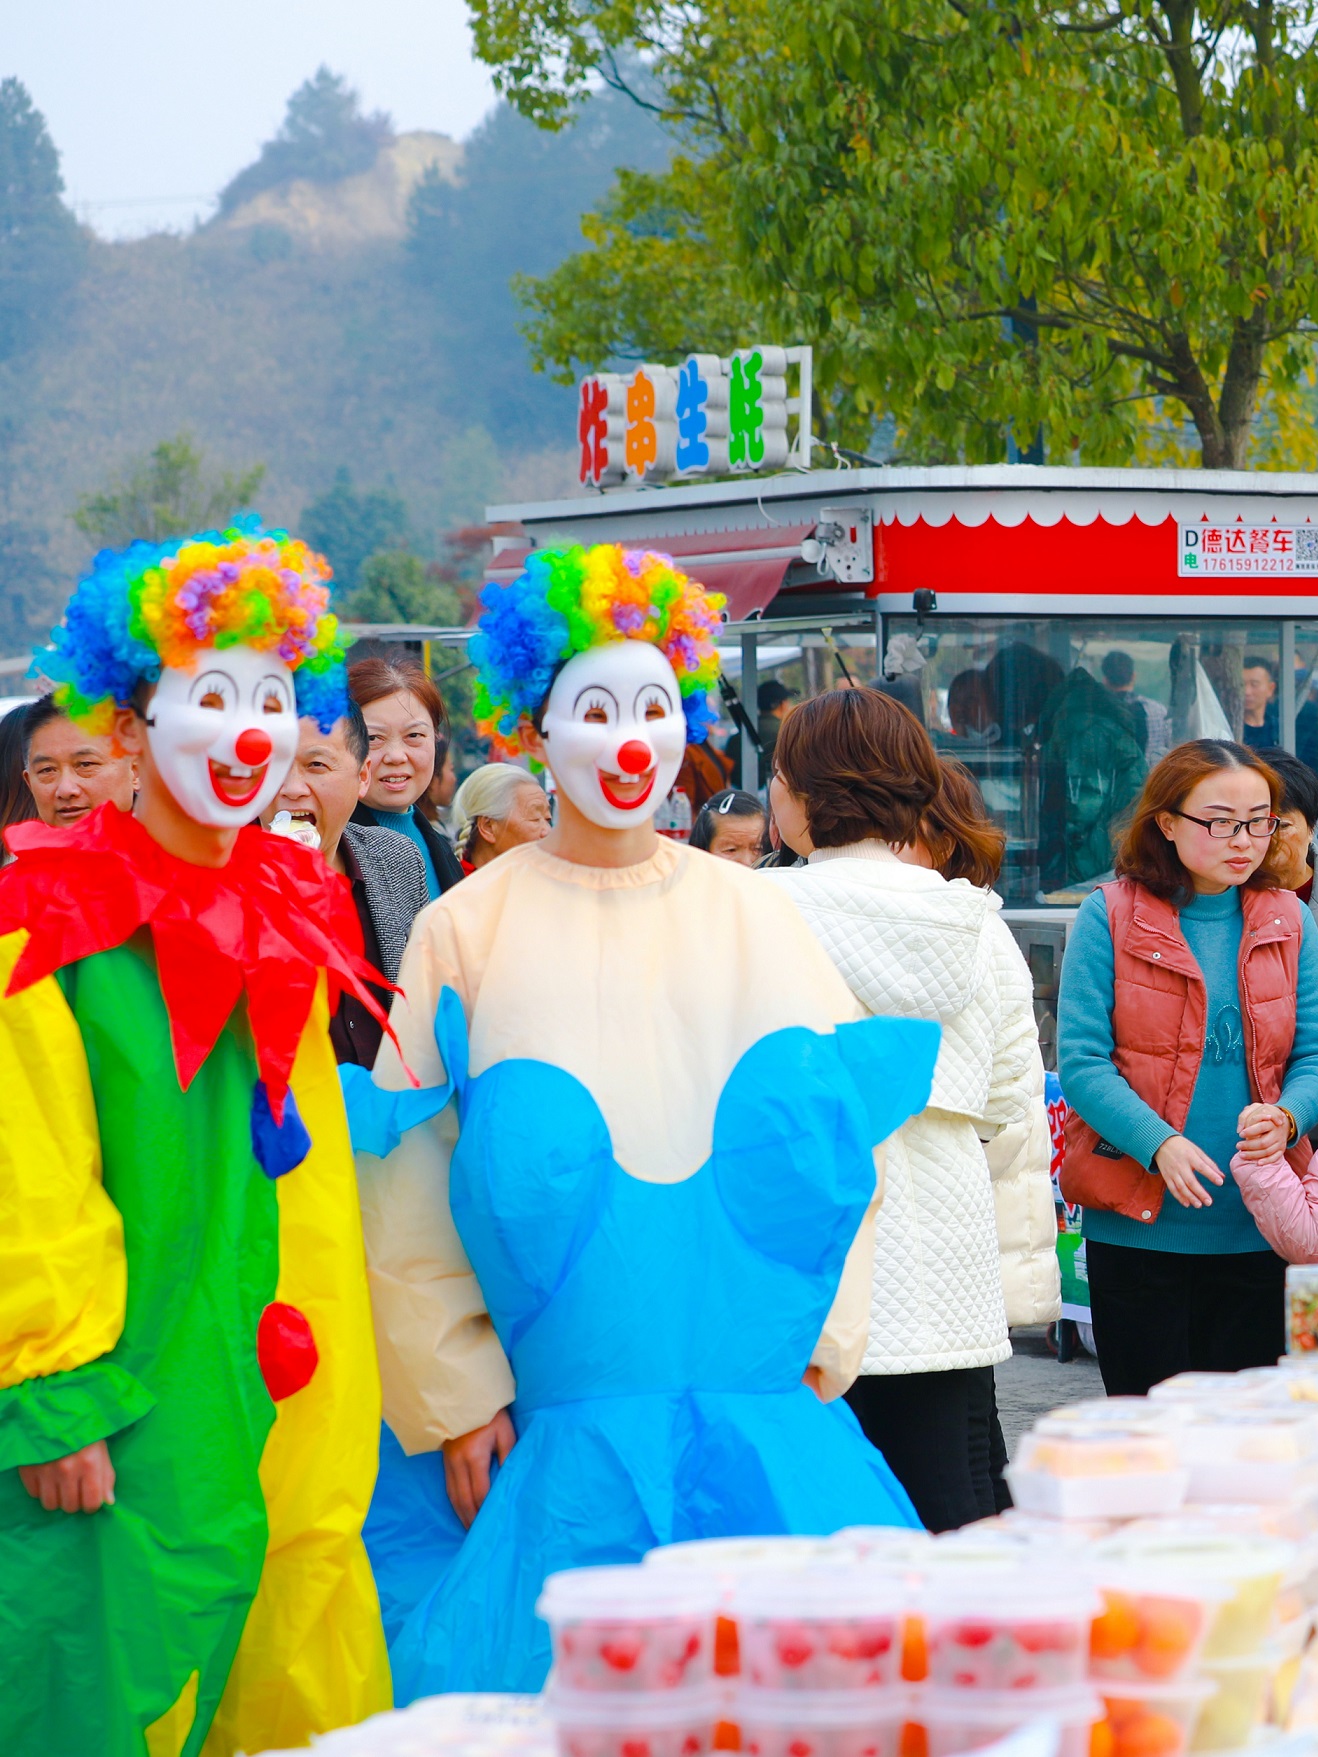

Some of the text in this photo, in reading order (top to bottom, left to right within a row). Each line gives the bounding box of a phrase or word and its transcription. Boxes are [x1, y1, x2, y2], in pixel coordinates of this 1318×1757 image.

[579, 351, 765, 484] 炸串生蚝
[1185, 528, 1294, 554] D 德达餐车
[1184, 552, 1199, 569] 电
[1203, 558, 1294, 571] 17615912212
